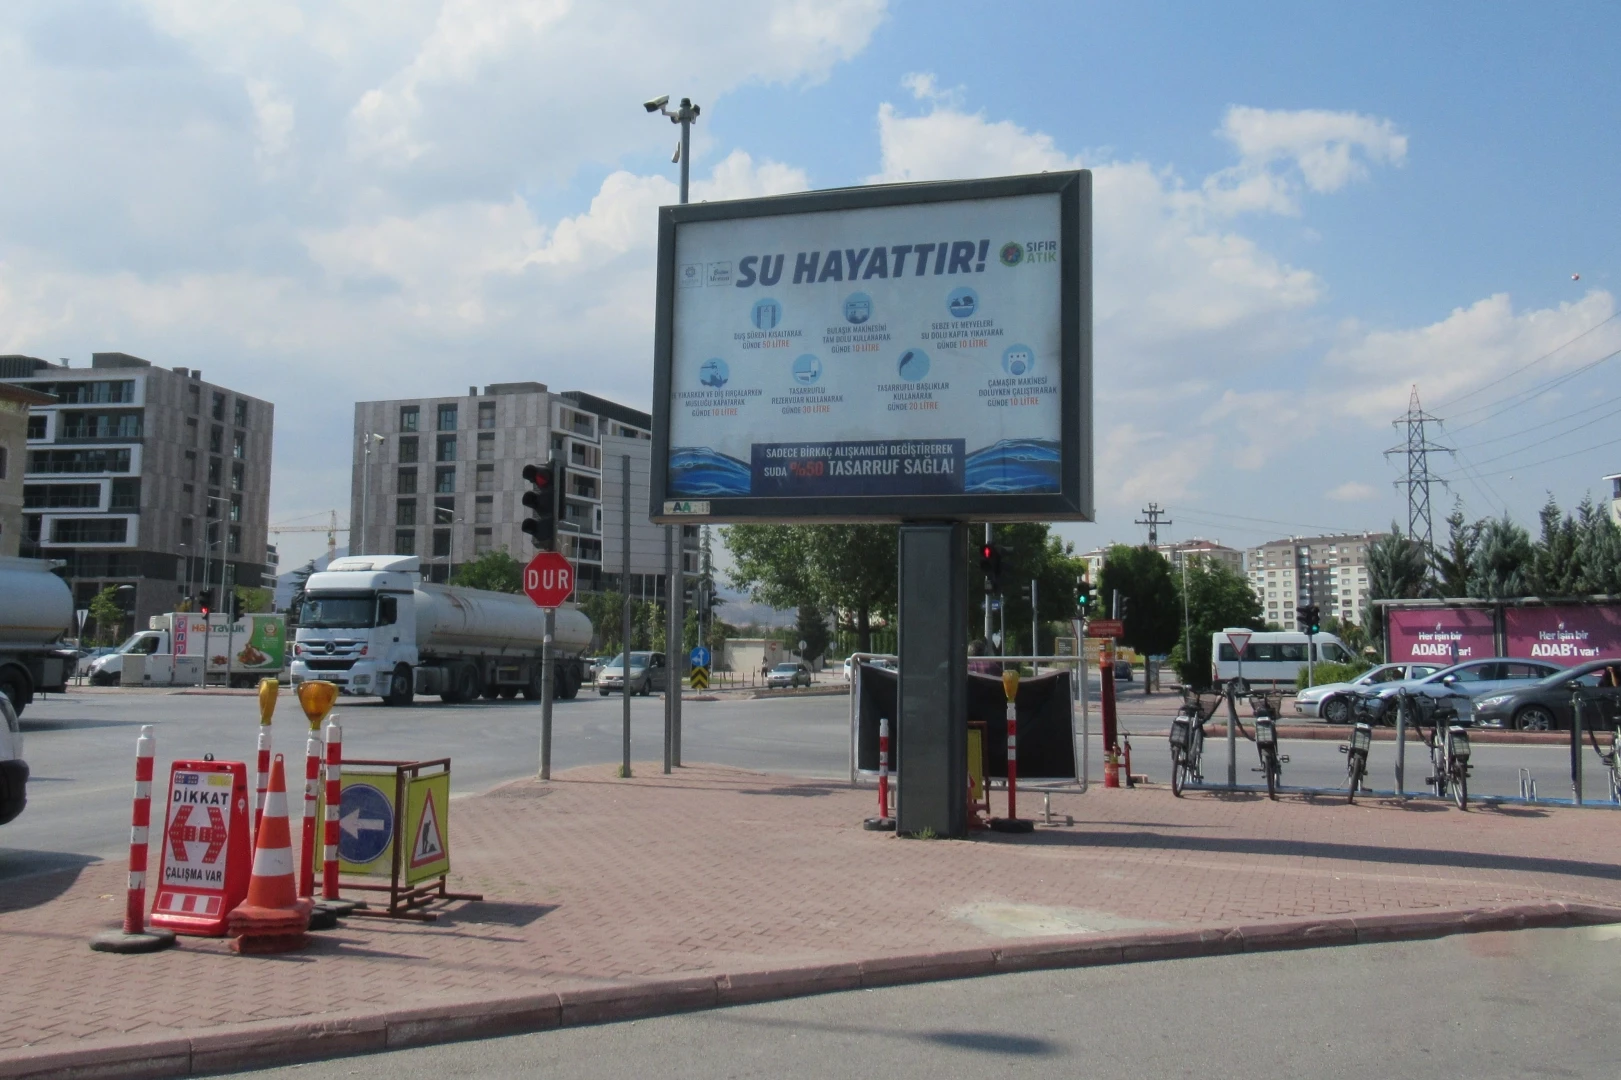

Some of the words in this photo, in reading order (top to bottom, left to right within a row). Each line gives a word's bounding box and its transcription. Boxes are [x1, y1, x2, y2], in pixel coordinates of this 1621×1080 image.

[1026, 241, 1056, 252] SIFIR
[1027, 252, 1056, 264] ATIK
[736, 254, 784, 288] SU
[792, 240, 990, 284] HAYATTIR!
[949, 330, 968, 338] KAPTA
[742, 341, 761, 350] GÜNDE
[772, 339, 790, 348] LİTRE
[831, 344, 850, 353] GÜNDE
[862, 342, 880, 352] LİTRE
[937, 340, 957, 349] GÜNDE
[960, 340, 967, 348] 10
[969, 338, 988, 348] LİTRE
[888, 402, 907, 411] GÜNDE
[920, 401, 938, 410] LİTRE
[988, 398, 1008, 406] GÜNDE
[1021, 396, 1039, 405] LİTRE
[692, 408, 710, 416] GÜNDE
[721, 407, 738, 416] LİTRE
[782, 406, 801, 414] GÜNDE
[802, 405, 811, 413] 30
[813, 404, 830, 413] LİTRE
[766, 448, 798, 458] SADECE
[800, 446, 832, 460] BİRKAÇ
[835, 444, 888, 459] ALIŞKANLIĞI
[890, 442, 953, 458] DEĞİŞTİREREK
[764, 467, 787, 477] SUDA
[790, 461, 823, 477] %50
[828, 459, 900, 475] TASARRUF
[904, 455, 954, 474] SAĞLA!
[528, 569, 568, 590] DUR
[1419, 632, 1433, 640] Her
[1434, 632, 1449, 642] işin
[1450, 632, 1462, 640] bir
[1539, 631, 1556, 640] Her
[1558, 631, 1574, 641] işin
[1576, 630, 1588, 640] bir
[1457, 647, 1471, 656] ar!
[1580, 647, 1599, 656] var!
[173, 787, 229, 805] DİKKAT
[166, 866, 202, 882] ÇALIŞMA
[205, 870, 222, 882] VAR
